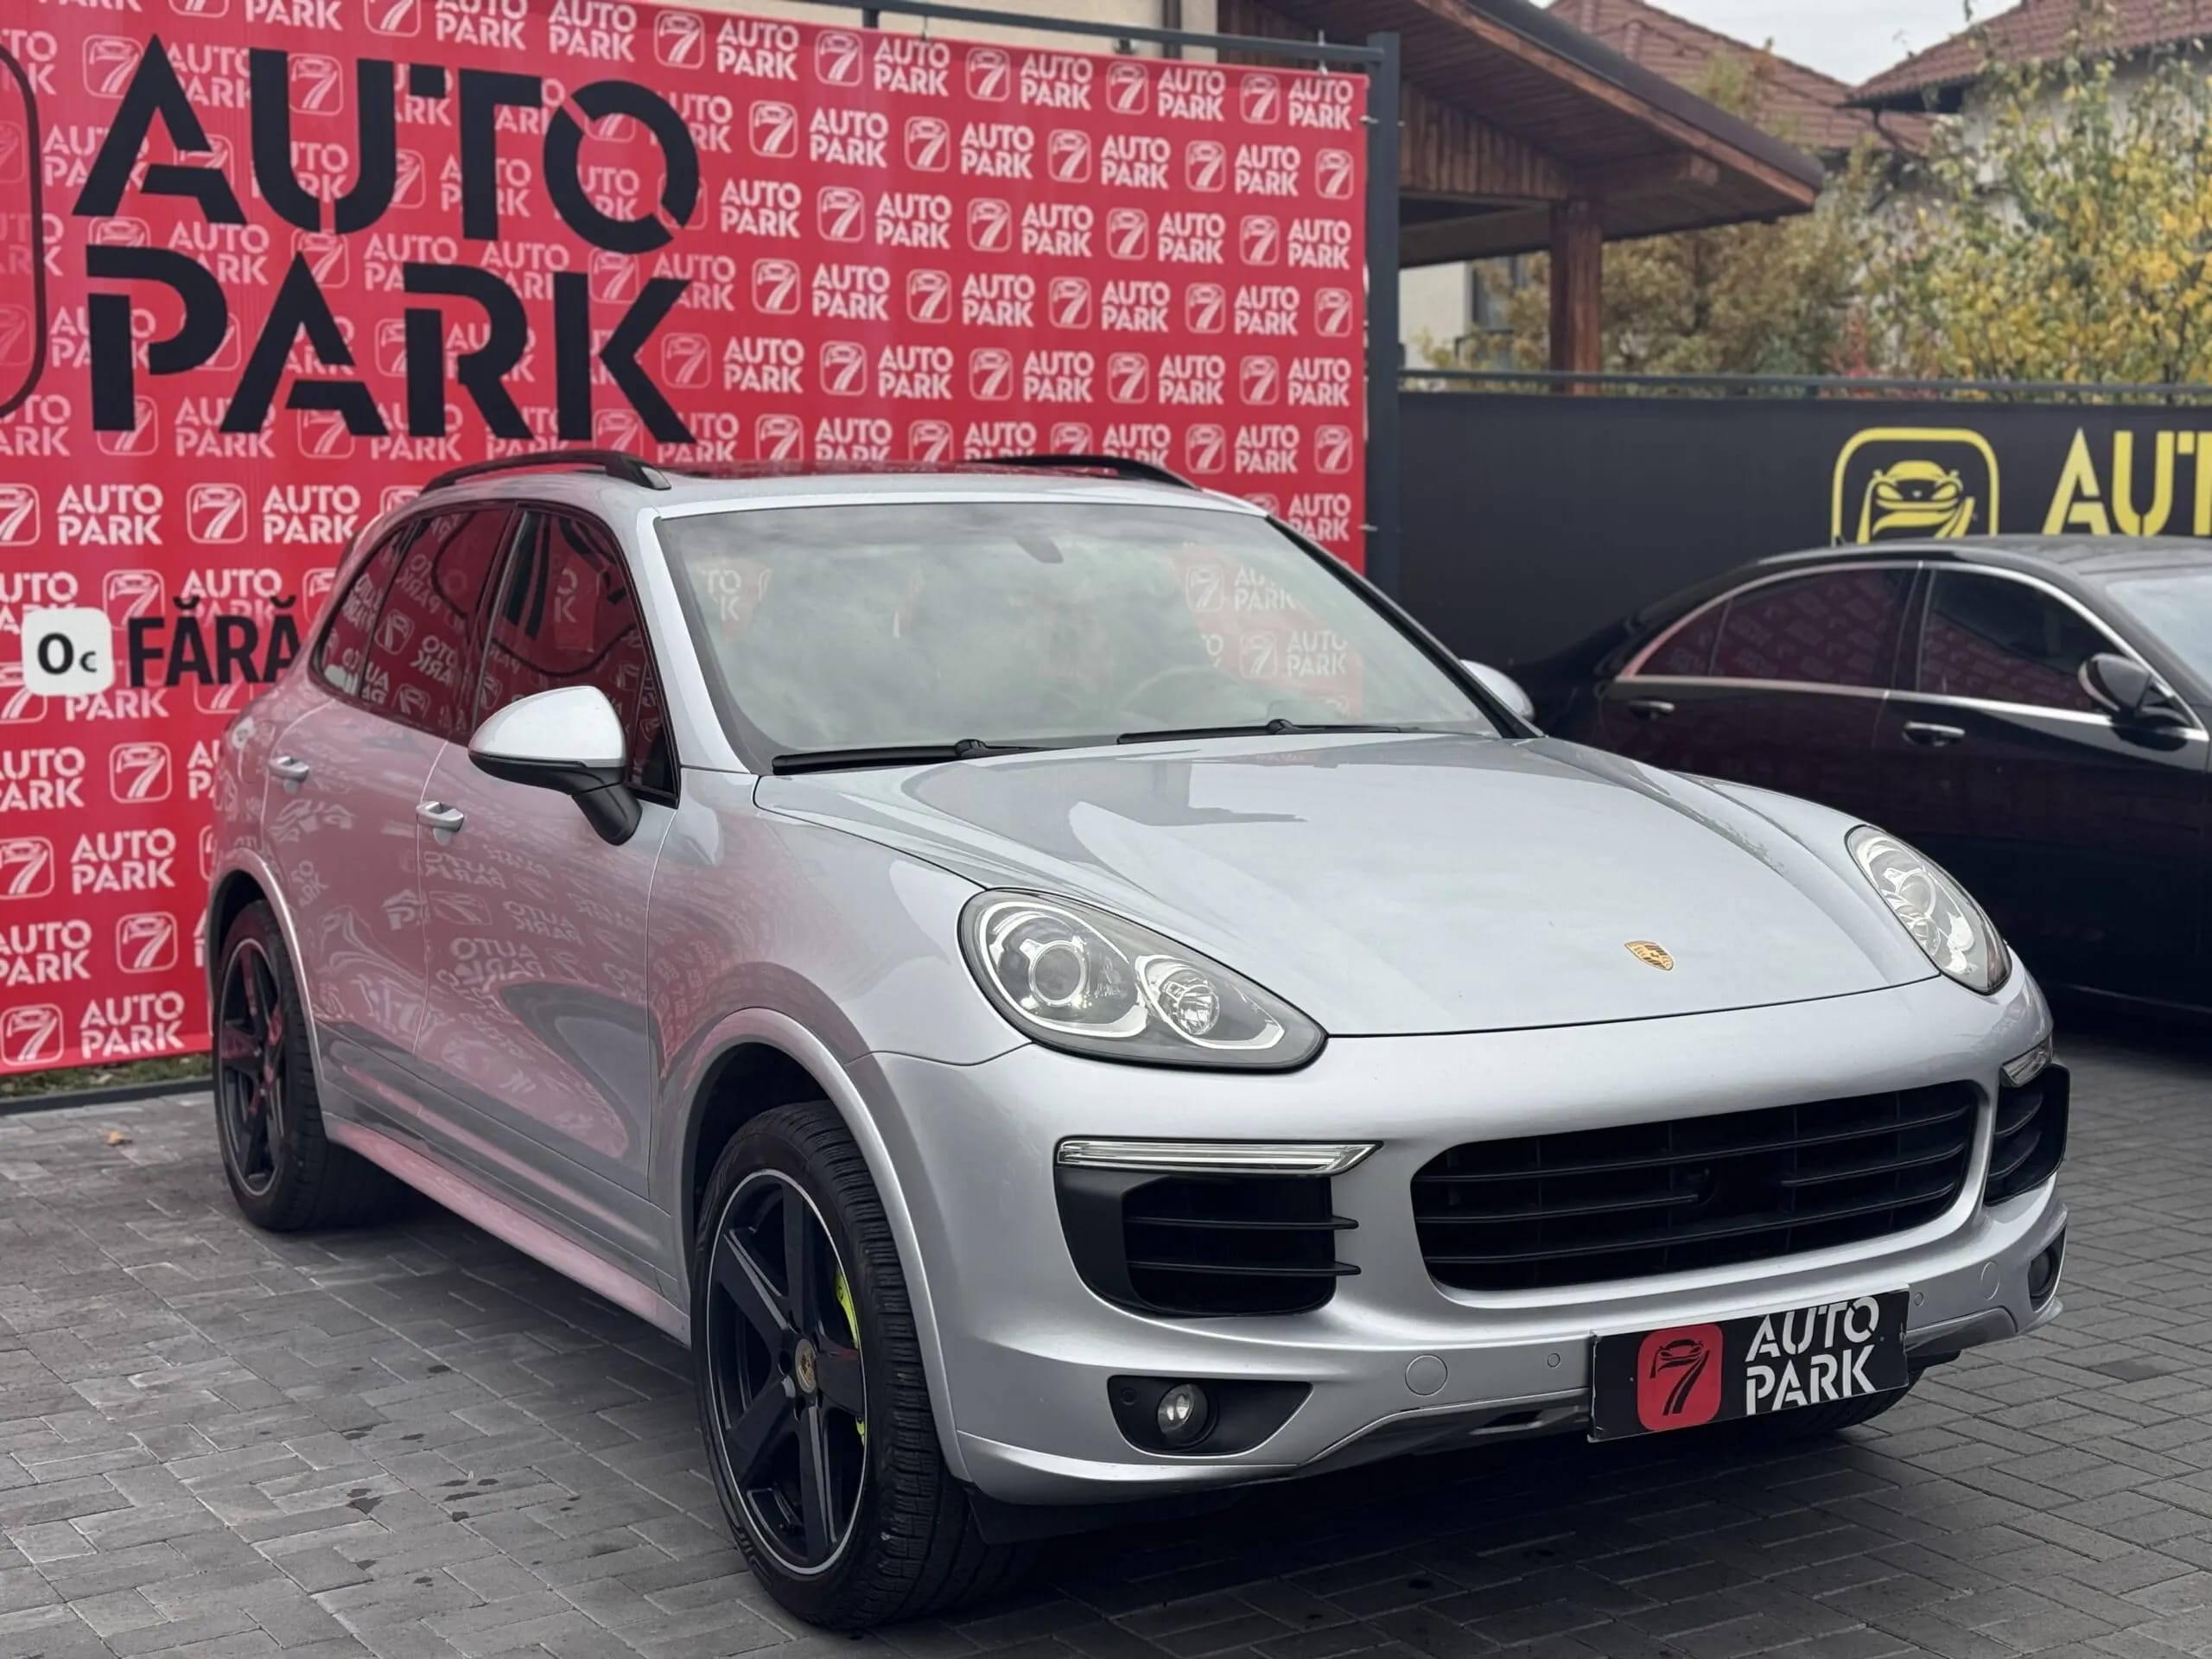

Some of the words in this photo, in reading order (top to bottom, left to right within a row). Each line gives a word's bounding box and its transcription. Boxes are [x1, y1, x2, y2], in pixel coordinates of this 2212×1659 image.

[549, 1, 637, 32] AUTO
[436, 13, 526, 50] PARK
[550, 26, 635, 62] PARK
[716, 19, 798, 52] AUTO
[716, 47, 798, 81] PARK
[874, 38, 950, 68] AUTO
[874, 63, 949, 97] PARK
[1020, 54, 1093, 83] AUTO
[1158, 68, 1225, 95] AUTO
[1020, 79, 1092, 111] PARK
[1288, 79, 1354, 105] AUTO
[1158, 94, 1224, 121] PARK
[1288, 102, 1351, 130] PARK
[810, 107, 888, 140] AUTO
[960, 122, 1034, 152] AUTO
[72, 34, 700, 255] AUTO
[810, 135, 887, 168] PARK
[1101, 135, 1171, 162] AUTO
[1235, 144, 1300, 170] AUTO
[961, 149, 1033, 180] PARK
[1101, 162, 1169, 190] PARK
[720, 178, 802, 210] AUTO
[1235, 169, 1299, 196] PARK
[721, 206, 801, 238] PARK
[875, 193, 951, 223] AUTO
[1021, 202, 1094, 230] AUTO
[168, 220, 269, 254] AUTO
[876, 219, 950, 250] PARK
[1158, 212, 1226, 239] AUTO
[1288, 219, 1351, 245] AUTO
[364, 233, 458, 264] AUTO
[480, 242, 569, 271] AUTO
[1021, 228, 1092, 257] PARK
[1158, 238, 1224, 264] PARK
[1288, 244, 1350, 270] PARK
[653, 253, 735, 283] AUTO
[812, 264, 890, 293] AUTO
[962, 273, 1035, 301] AUTO
[1101, 281, 1171, 307] AUTO
[1235, 285, 1300, 311] AUTO
[812, 290, 889, 321] PARK
[963, 300, 1033, 327] PARK
[1102, 306, 1169, 332] PARK
[1235, 310, 1298, 336] PARK
[86, 245, 697, 443] PARK
[723, 336, 804, 365] AUTO
[878, 346, 954, 374] AUTO
[1023, 350, 1094, 377] AUTO
[1159, 354, 1225, 380] AUTO
[1288, 358, 1351, 383] AUTO
[724, 364, 804, 394] PARK
[878, 371, 953, 400] PARK
[1024, 376, 1093, 403] PARK
[1159, 379, 1224, 404] PARK
[1288, 381, 1350, 406] PARK
[176, 429, 275, 458] PARK
[815, 417, 892, 445] AUTO
[964, 423, 1036, 447] AUTO
[1103, 424, 1171, 449] AUTO
[1235, 426, 1300, 449] AUTO
[371, 435, 461, 461] PARK
[1235, 449, 1298, 474] PARK
[57, 484, 163, 514] AUTO
[262, 485, 360, 514] AUTO
[1288, 493, 1351, 517] AUTO
[58, 515, 163, 545] PARK
[263, 516, 354, 543] PARK
[181, 569, 283, 601] AUTO
[65, 689, 168, 721] PARK
[72, 829, 176, 863] AUTO
[72, 859, 175, 894] PARK
[80, 992, 184, 1030] AUTO
[80, 1021, 184, 1059] PARK
[1745, 1296, 1880, 1363] AUTO
[1745, 1344, 1876, 1417] PARK
